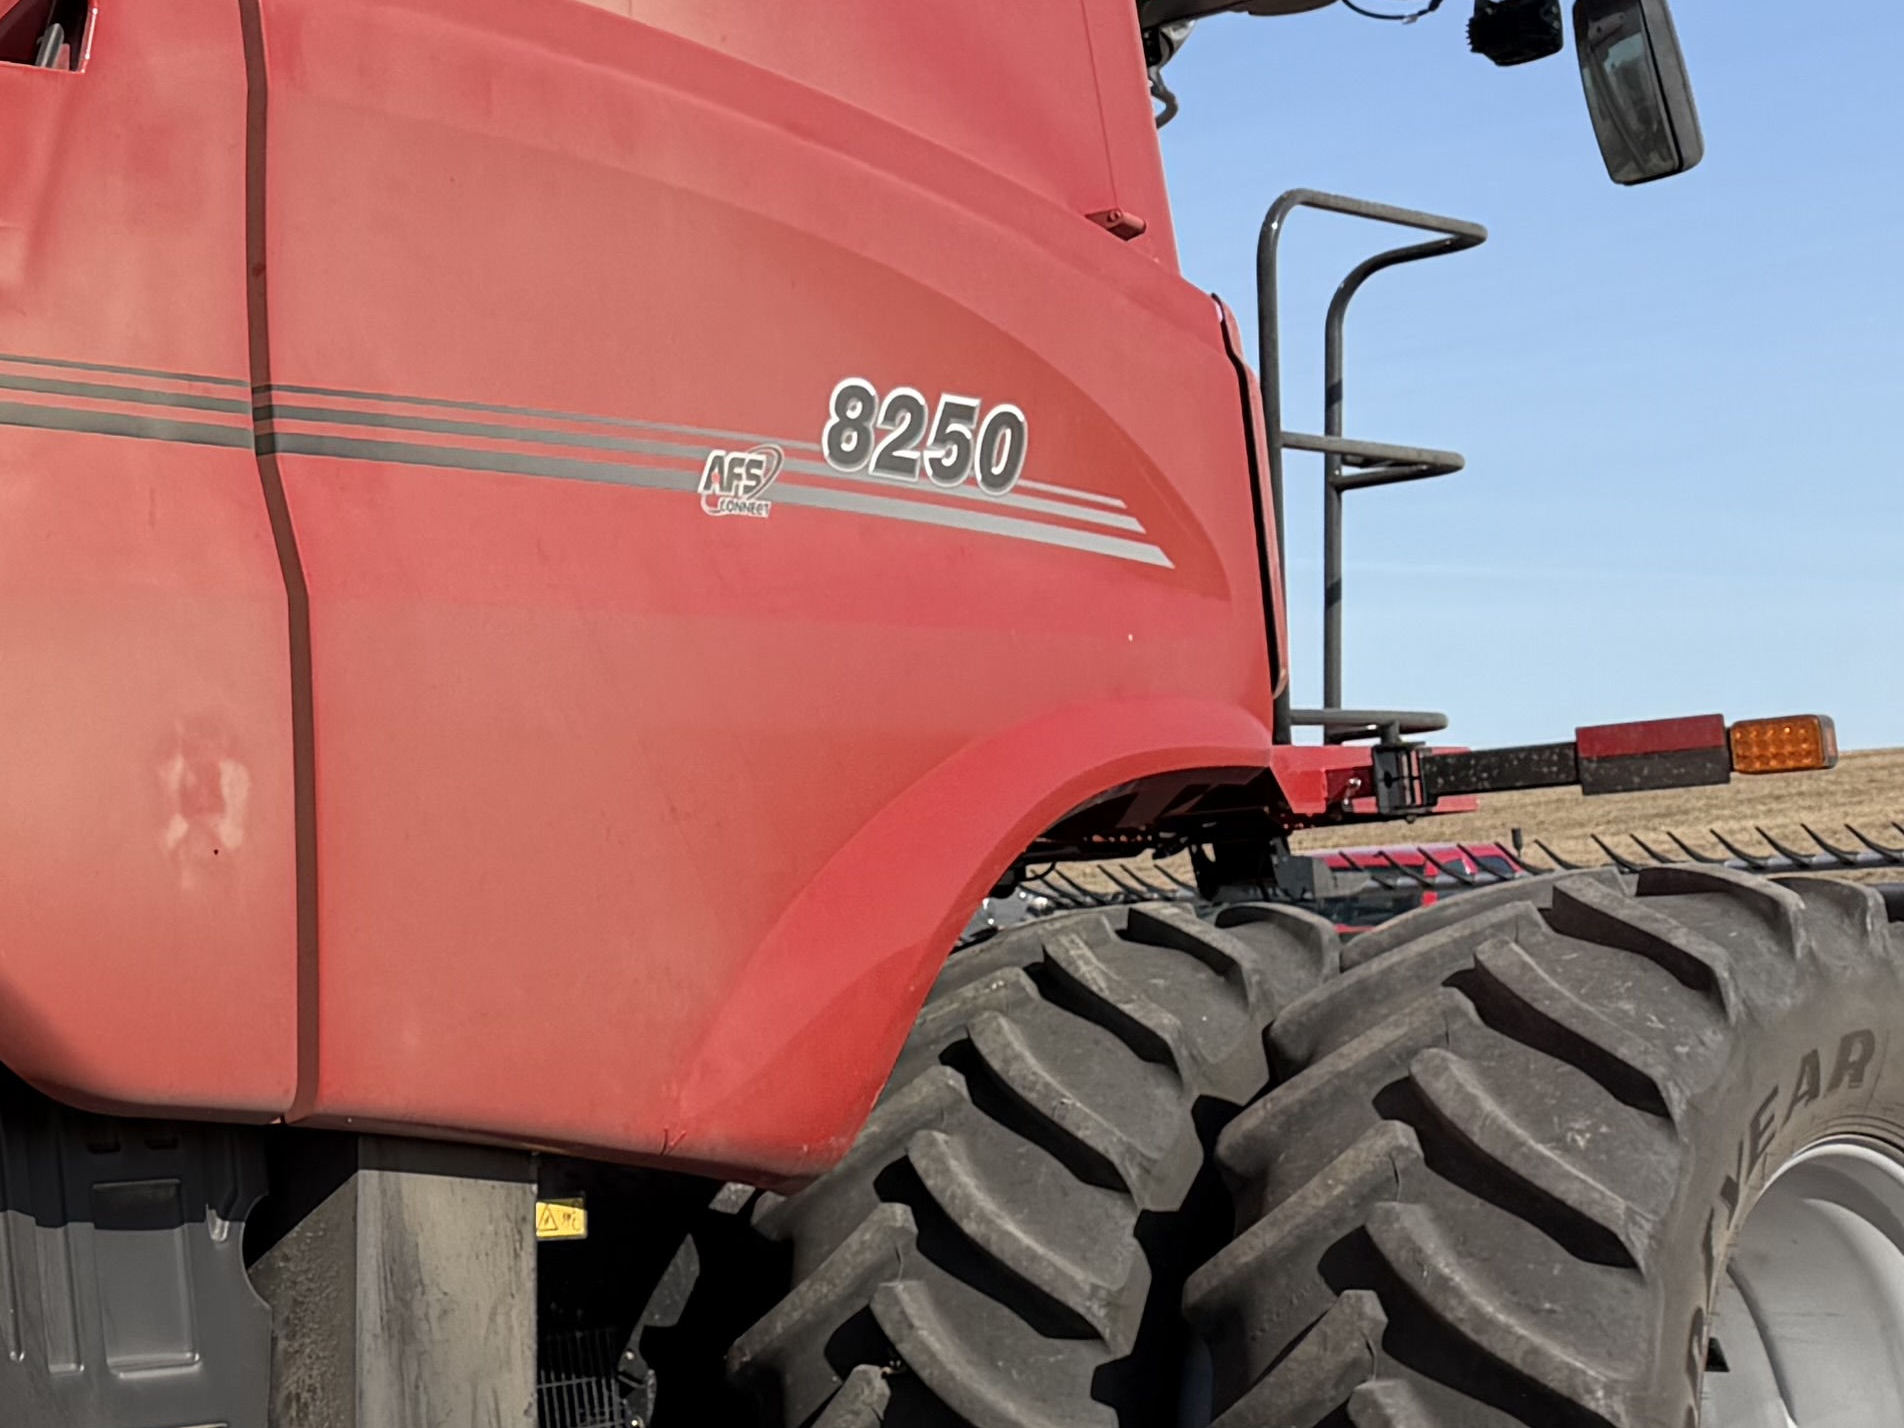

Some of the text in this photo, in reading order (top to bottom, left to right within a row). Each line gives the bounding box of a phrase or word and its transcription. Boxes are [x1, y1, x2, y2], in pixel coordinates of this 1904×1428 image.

[823, 378, 1028, 497] 8250
[698, 449, 767, 497] AFS
[718, 497, 772, 518] CONNECT
